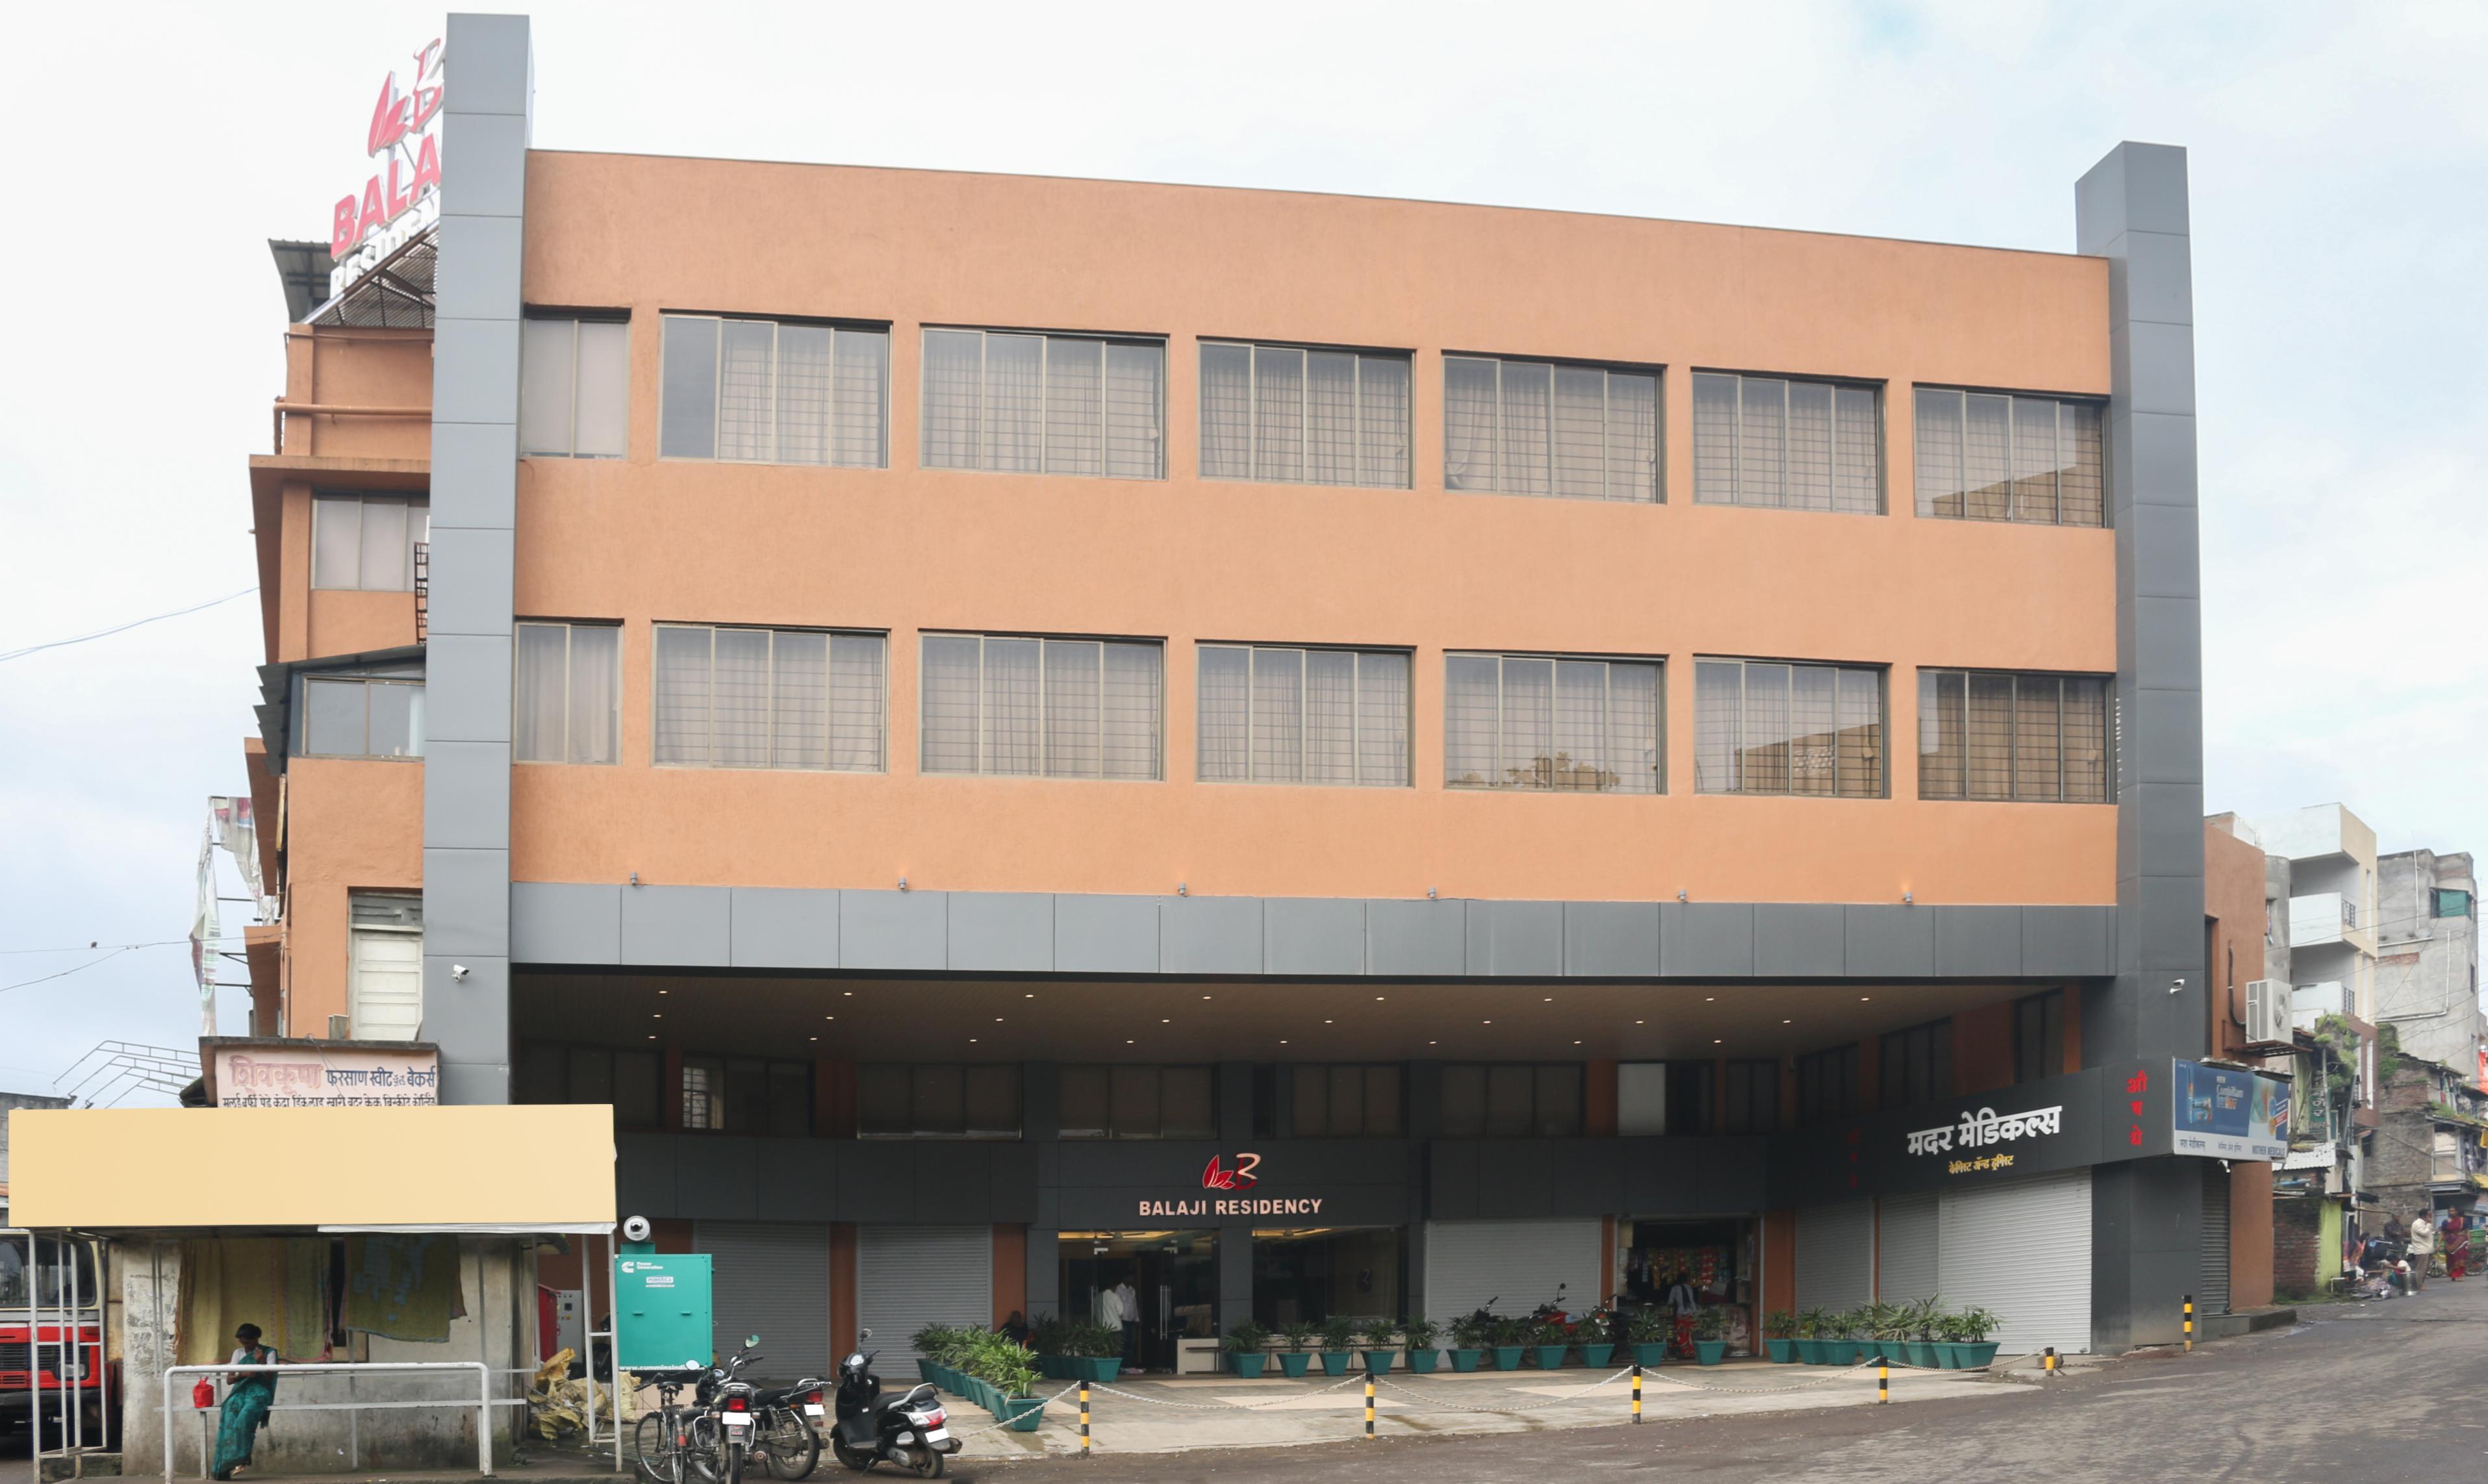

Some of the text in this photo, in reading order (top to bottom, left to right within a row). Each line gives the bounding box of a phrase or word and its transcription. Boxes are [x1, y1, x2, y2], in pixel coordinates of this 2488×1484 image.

[330, 132, 441, 262] BALA
[329, 189, 440, 299] RESIDEN
[325, 1070, 368, 1087] फरसाण
[407, 1065, 436, 1087] बेकर्स
[1907, 1105, 2063, 1156] मदर मेडिकल्स
[1139, 1198, 1323, 1216] BALAJI RESIDENCY
